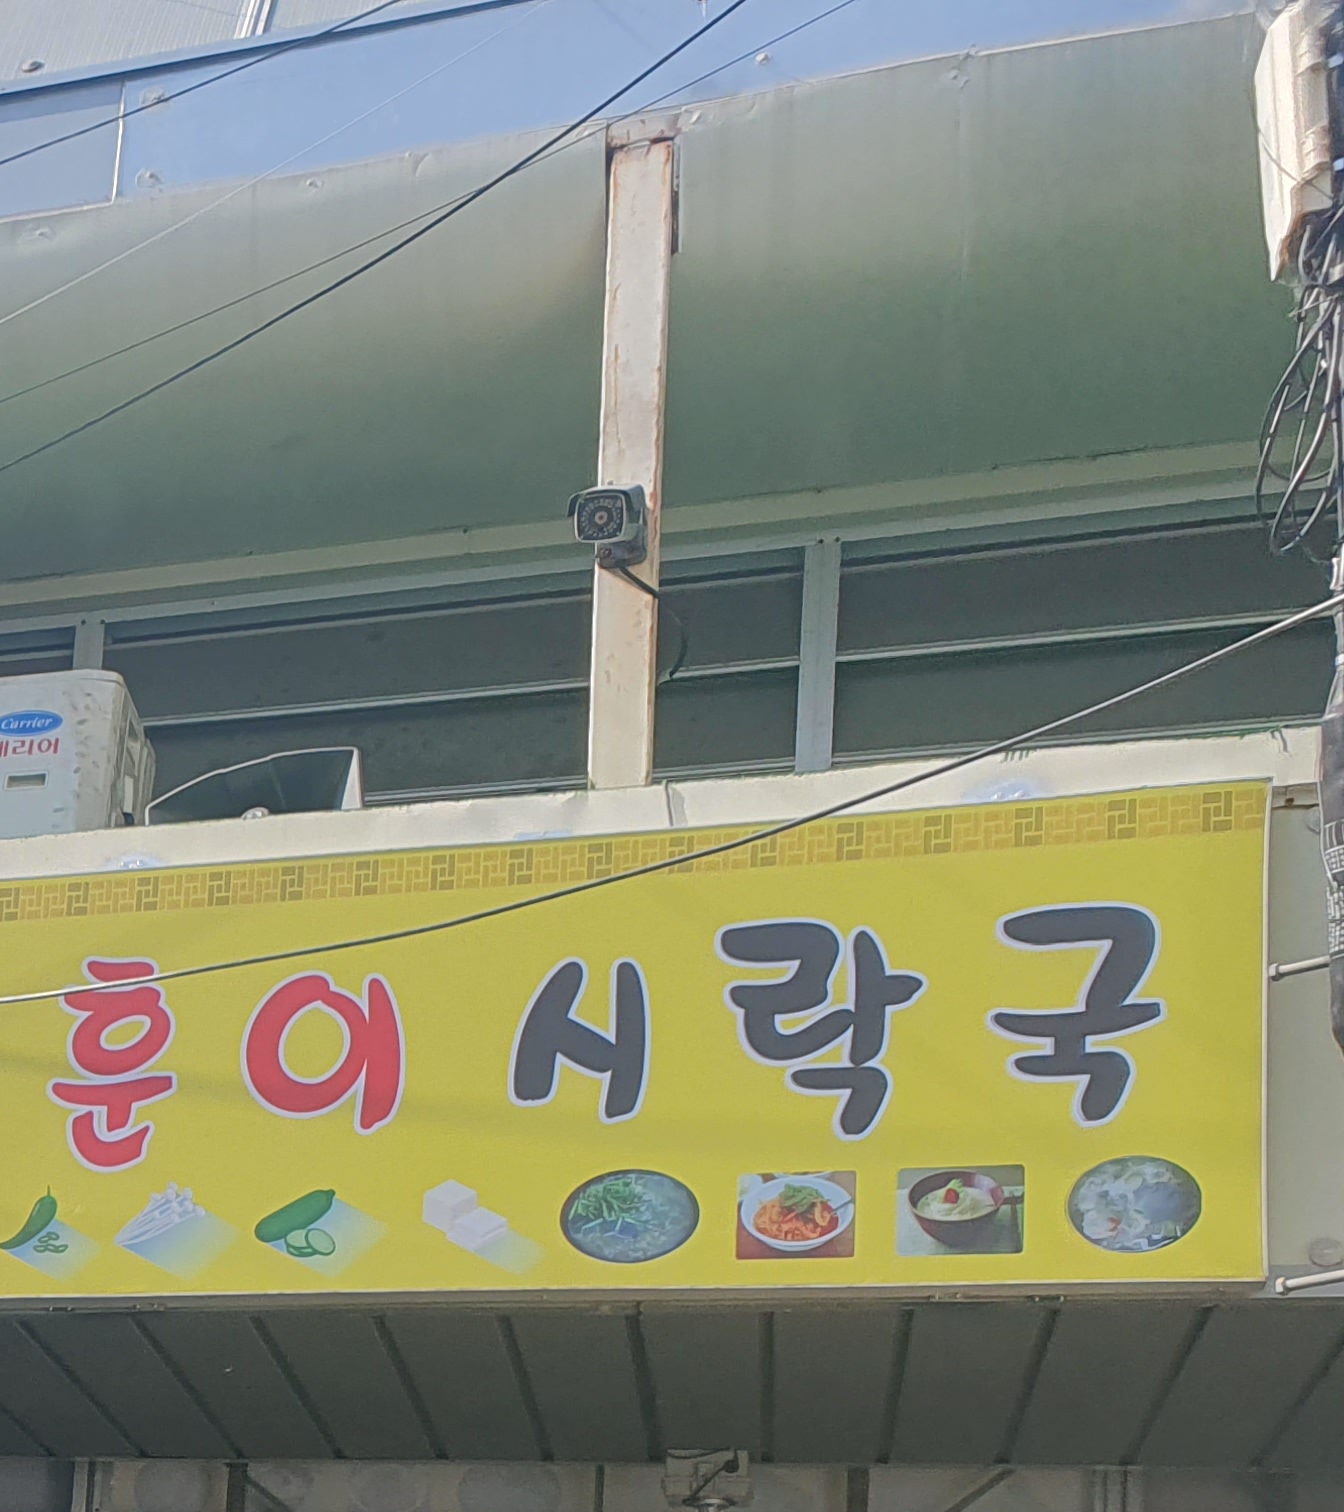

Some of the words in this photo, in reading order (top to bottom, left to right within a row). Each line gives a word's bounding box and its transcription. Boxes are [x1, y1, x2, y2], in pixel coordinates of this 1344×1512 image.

[0, 716, 54, 731] Carrier
[47, 955, 407, 1172] 훈이
[508, 902, 1167, 1140] 시락국
